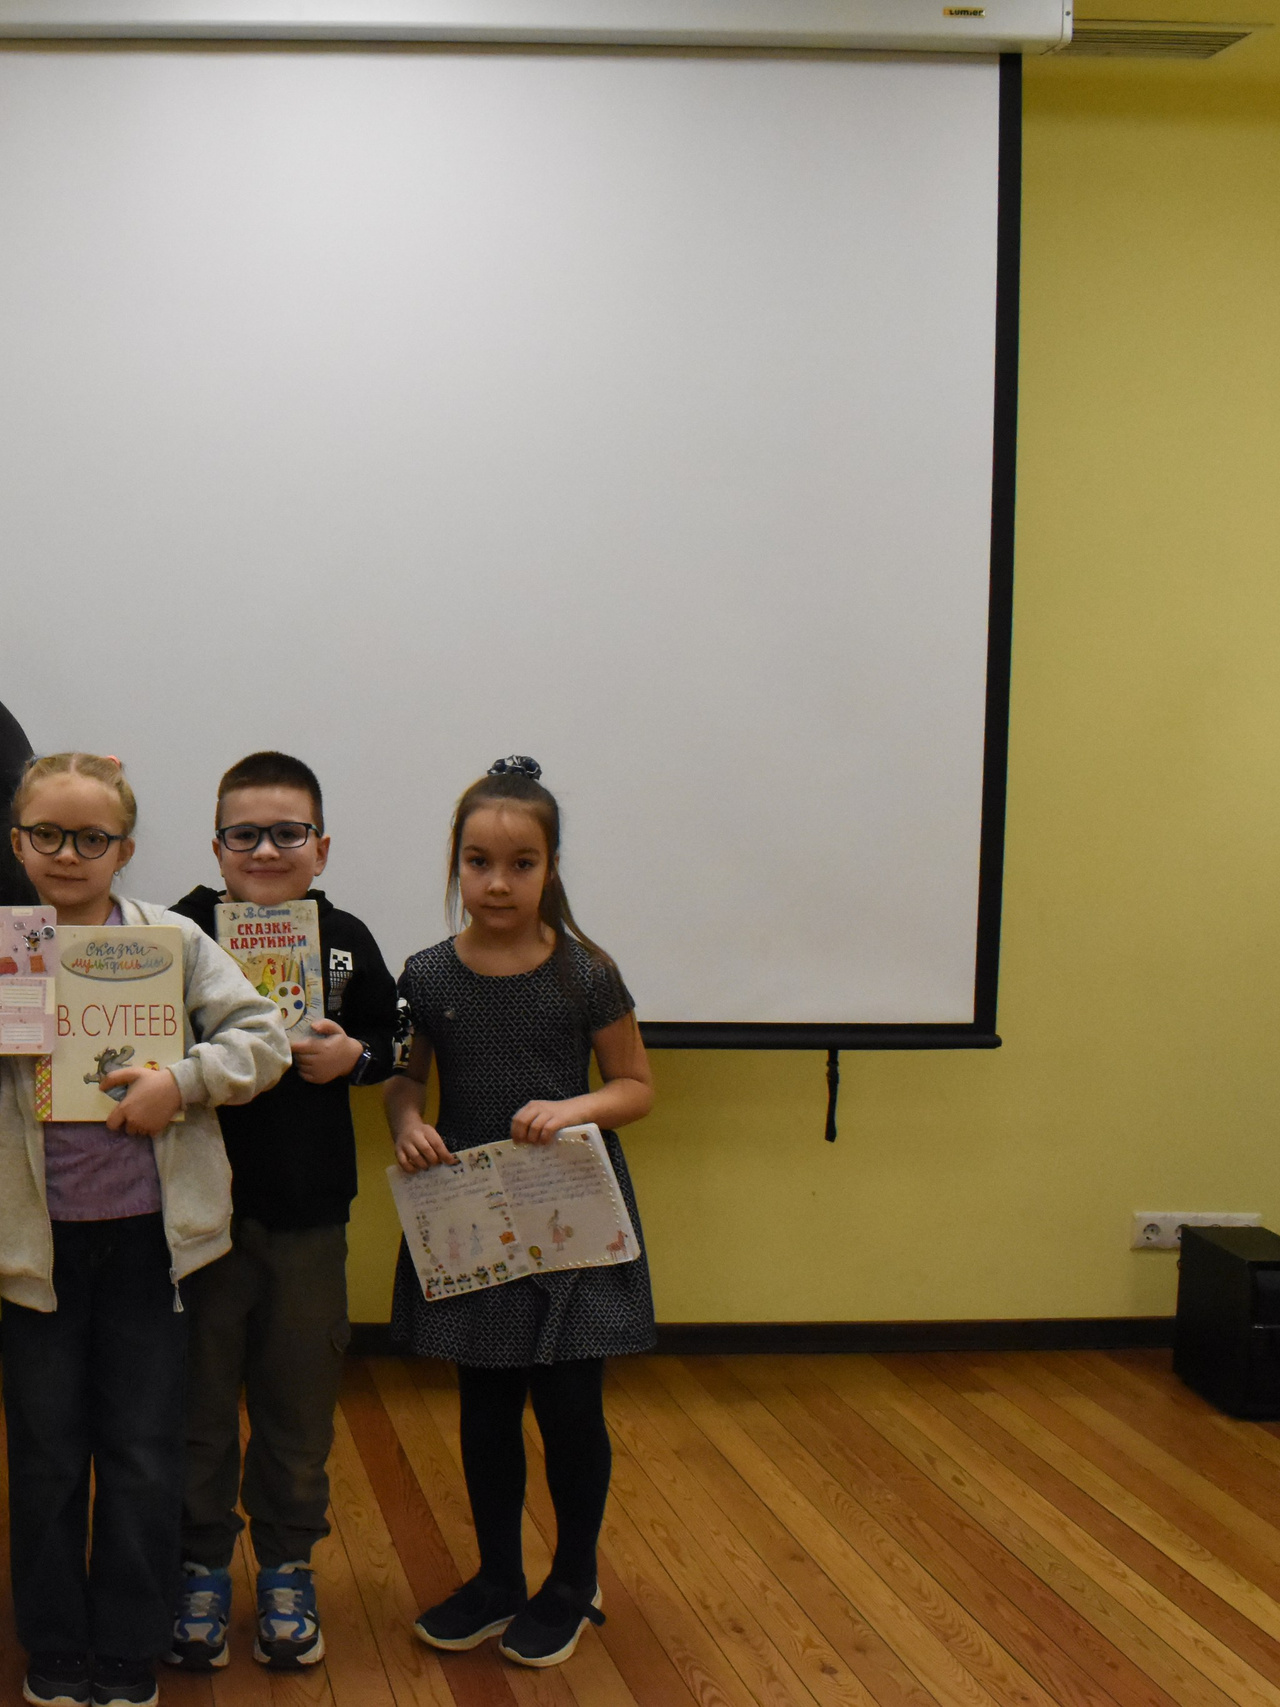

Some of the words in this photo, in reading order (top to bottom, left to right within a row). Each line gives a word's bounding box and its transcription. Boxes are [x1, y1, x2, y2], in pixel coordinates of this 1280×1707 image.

[230, 935, 307, 950] КАРТИНКИ
[71, 956, 164, 974] мультфильмы
[57, 1004, 76, 1037] В.
[81, 1004, 178, 1037] СУТЕЕВ
